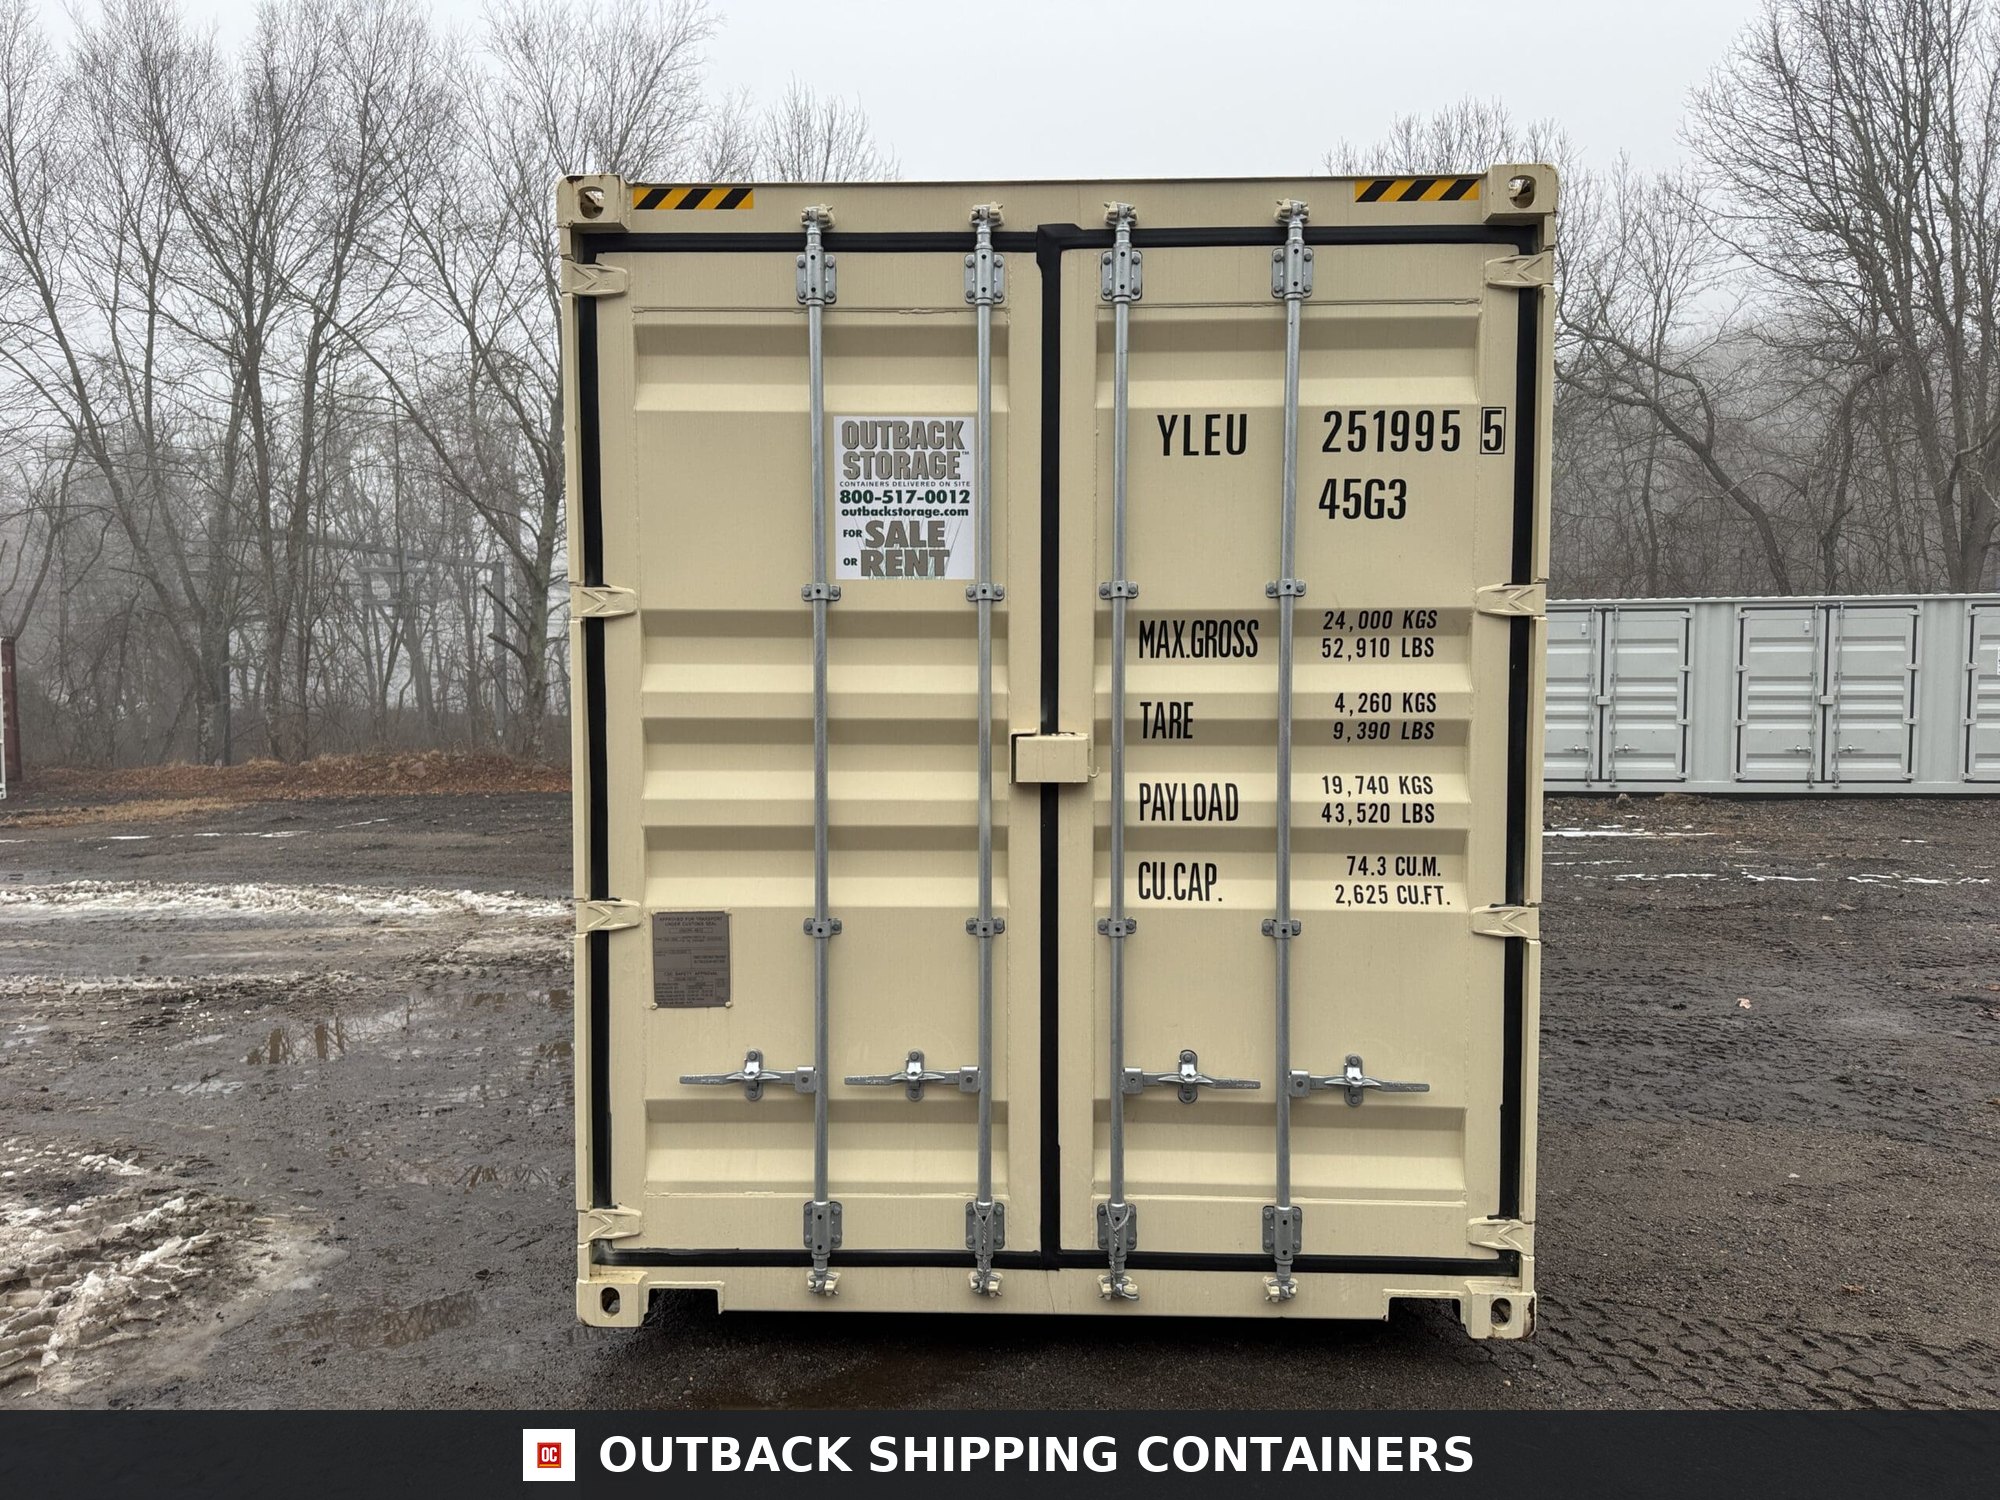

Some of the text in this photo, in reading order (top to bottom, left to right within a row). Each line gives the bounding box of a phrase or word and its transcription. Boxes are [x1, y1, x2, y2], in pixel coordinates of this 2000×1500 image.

[841, 420, 965, 450] OUTBACK
[1157, 409, 1503, 456] YLEU 251995 5
[842, 451, 961, 480] STORAGE
[839, 489, 971, 504] 800-517-0012
[1318, 478, 1407, 520] 45G3
[841, 506, 969, 519] outbackstorage.com
[842, 519, 946, 549] FOR SALE
[843, 549, 951, 577] OR RENT
[1322, 609, 1438, 633] 24,000 KGS
[1138, 619, 1260, 659] MAX.GROSS
[1321, 636, 1435, 661] 52,910 LBS
[1334, 692, 1437, 716] 4,260 KGS
[1139, 701, 1194, 740] TARE
[1332, 721, 1435, 743] 9,390 LBS
[1321, 775, 1434, 797] 19,740 KGS
[1139, 783, 1239, 822] PAYLOAD
[1321, 802, 1435, 826] 43,520 LBS
[1346, 855, 1441, 877] 74.3 CU.M.
[1138, 861, 1223, 902] CU.CAP.
[1335, 884, 1451, 906] 2,625 CU.FT.
